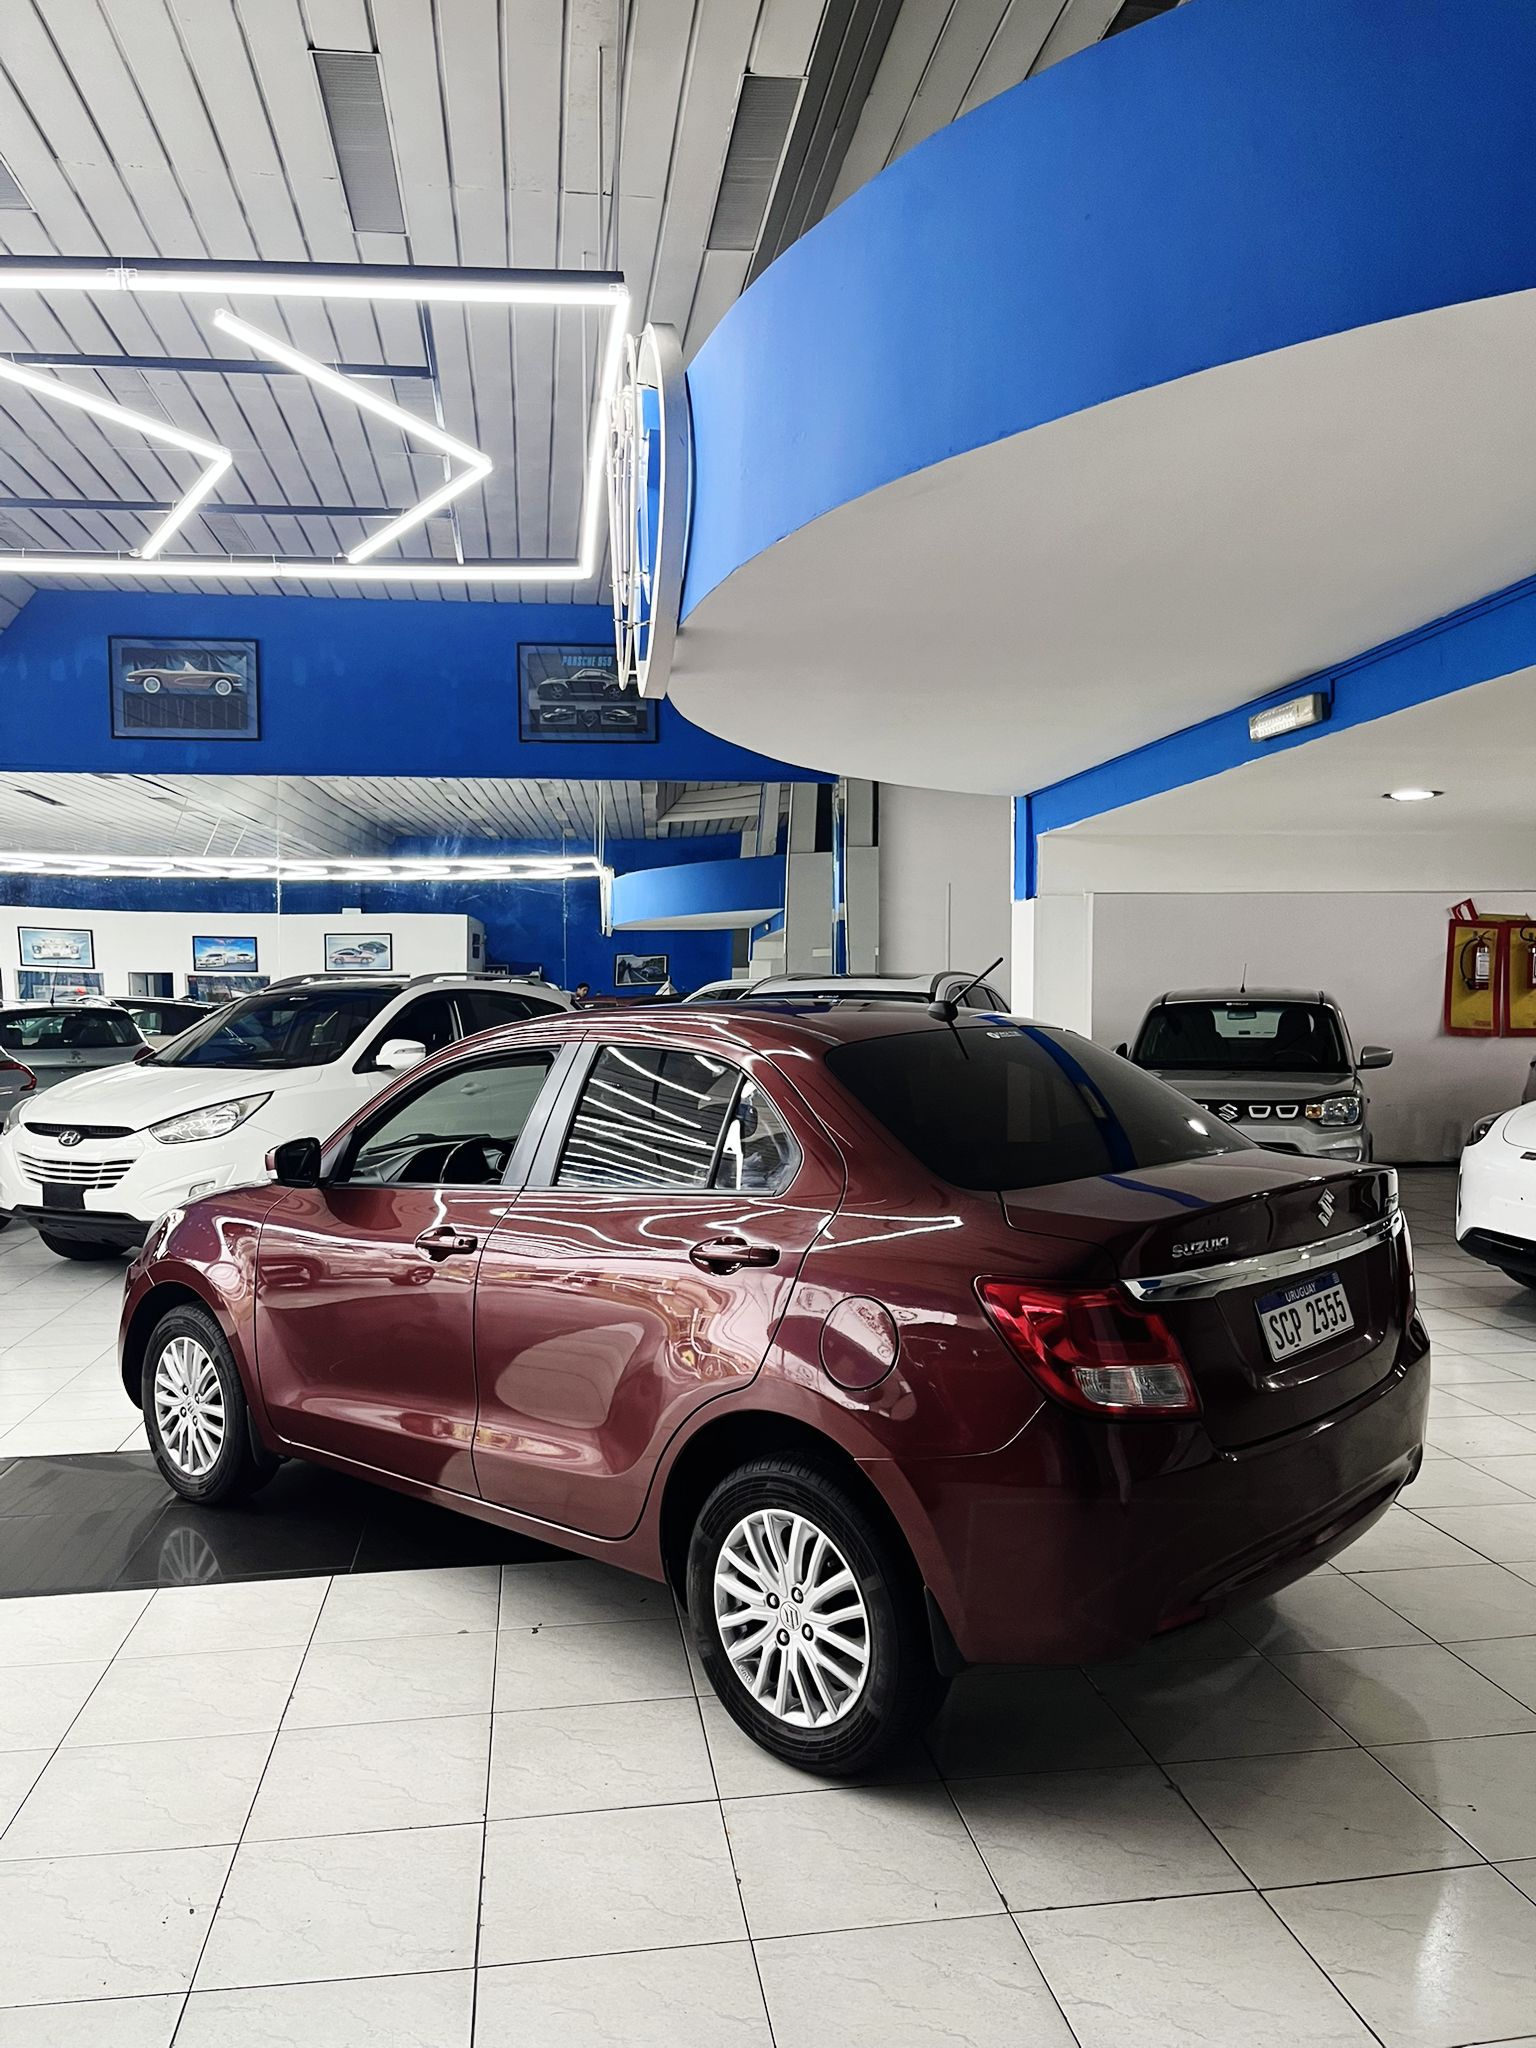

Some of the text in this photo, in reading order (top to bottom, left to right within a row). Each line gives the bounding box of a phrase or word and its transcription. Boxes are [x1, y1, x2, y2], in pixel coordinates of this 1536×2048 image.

[1171, 1236, 1229, 1258] SUZUKI
[1284, 1282, 1317, 1302] URUGUAY
[1269, 1290, 1347, 1350] SCP 2555
